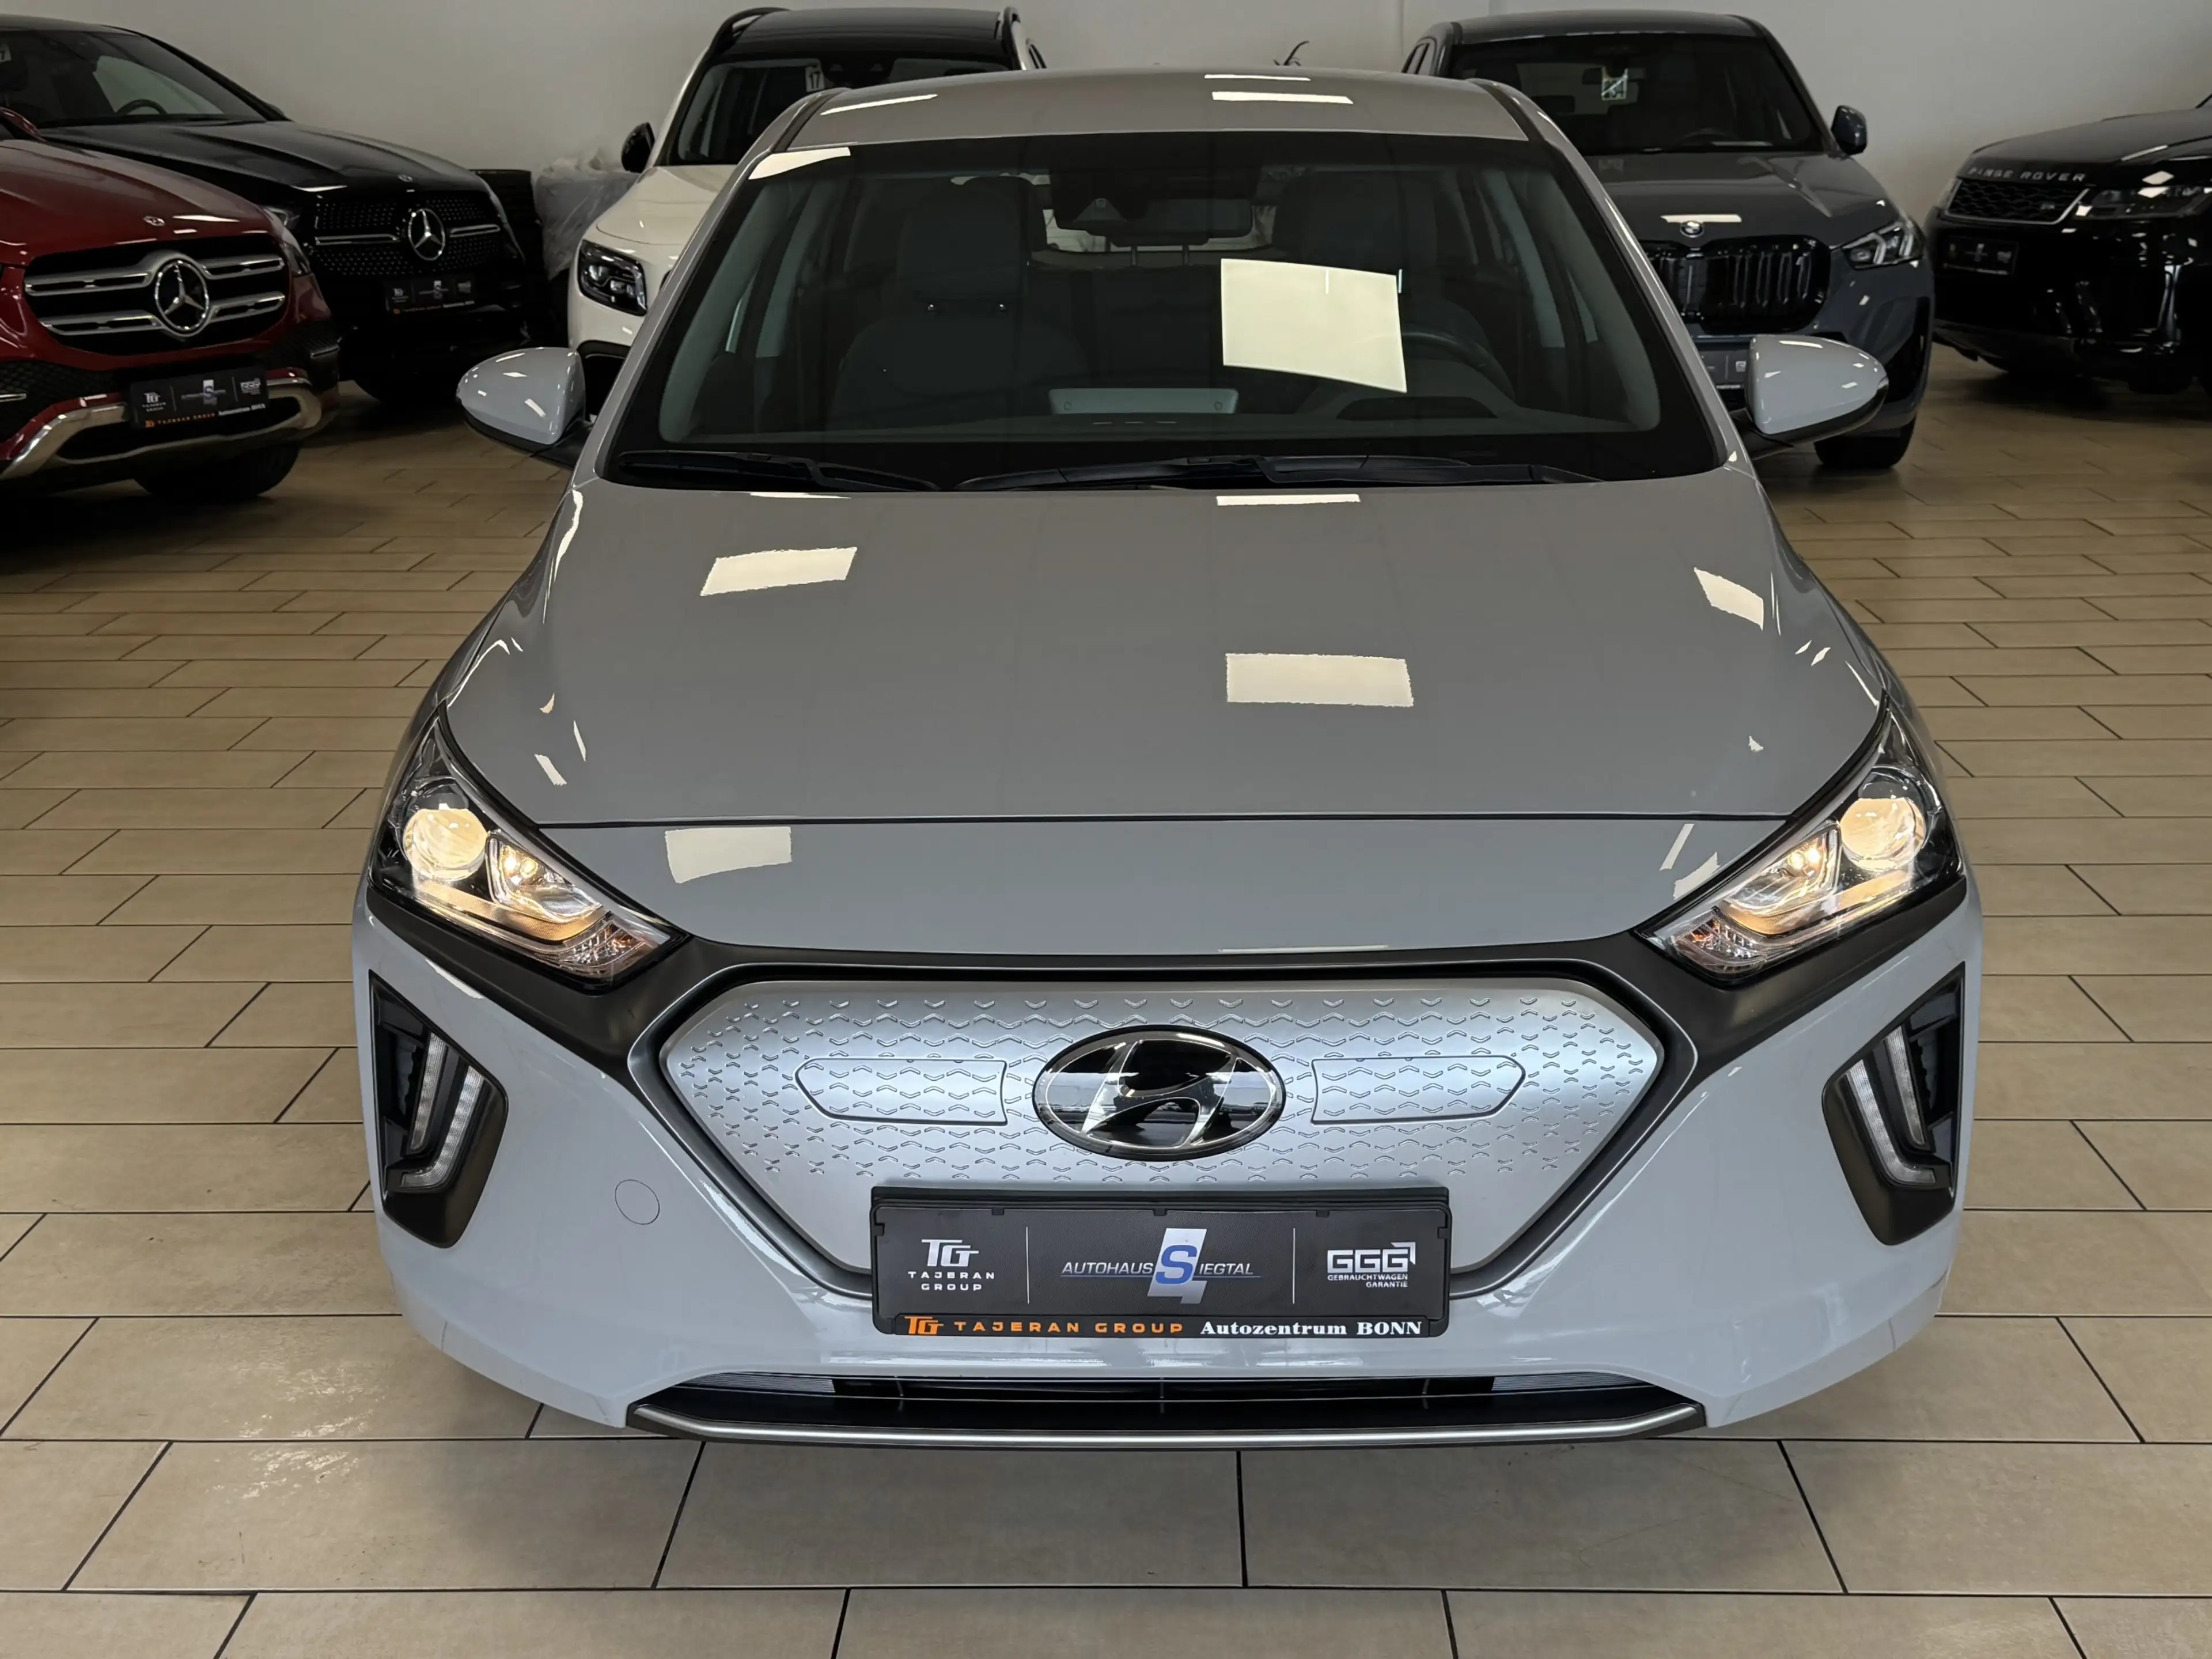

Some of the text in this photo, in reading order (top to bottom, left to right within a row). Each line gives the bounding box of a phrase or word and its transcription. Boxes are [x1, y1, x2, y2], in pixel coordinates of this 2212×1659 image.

[2020, 171, 2085, 182] ROVER
[922, 1239, 979, 1267] TG
[1327, 1248, 1408, 1274] GGG
[908, 1271, 995, 1279] TAJERAN
[1062, 1262, 1154, 1275] AUTOHAUS
[1327, 1273, 1408, 1281] GEBRAUCHTWAGEN
[954, 1321, 1080, 1332] TAJERAN
[1095, 1323, 1183, 1333] GROUP
[1200, 1321, 1347, 1335] Autozentrum
[1356, 1321, 1422, 1335] BONN
